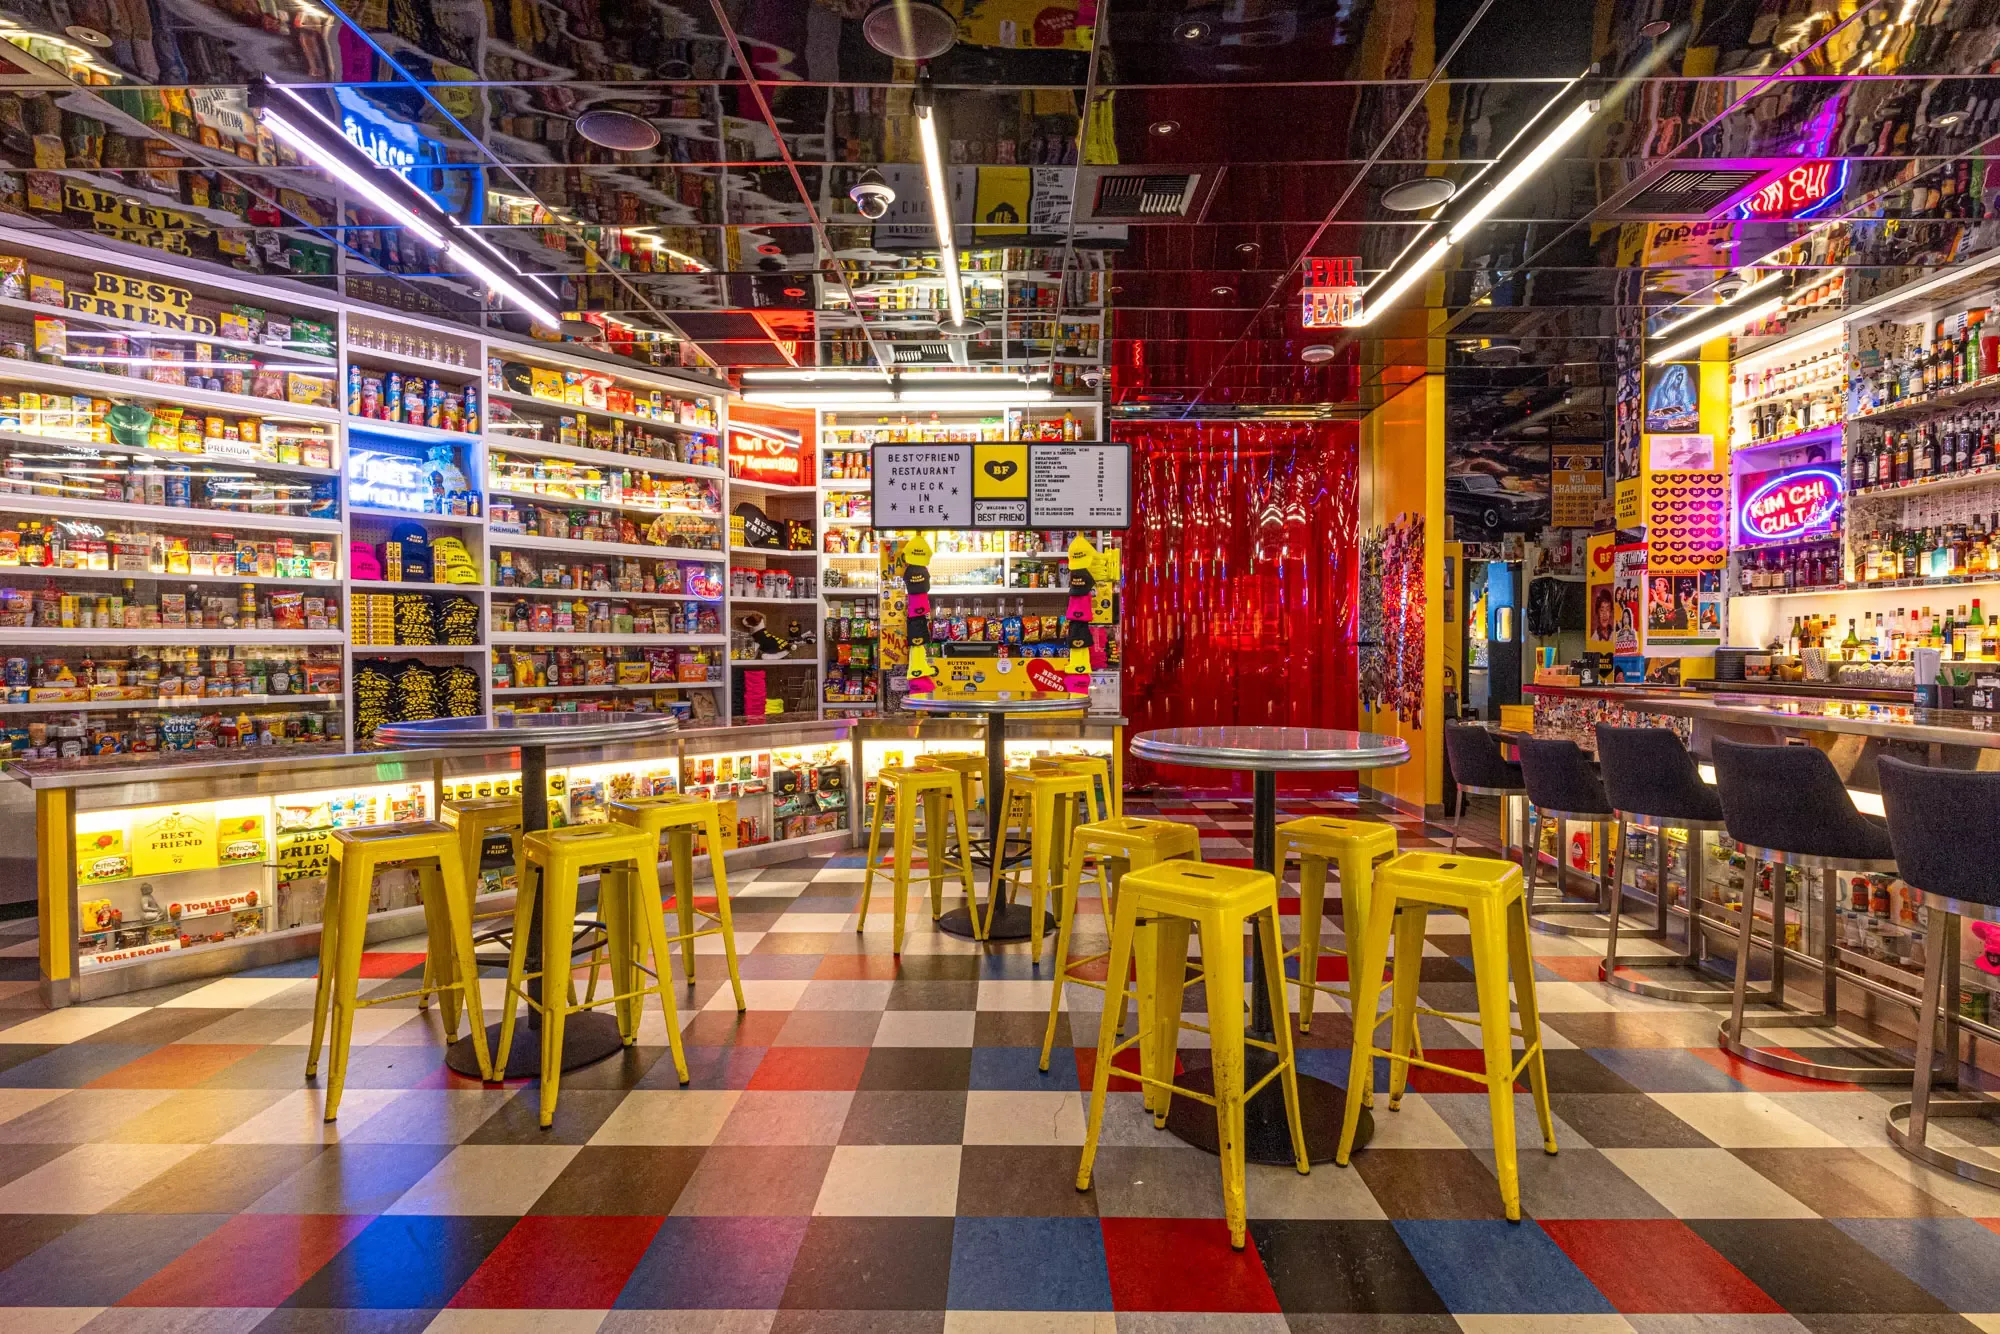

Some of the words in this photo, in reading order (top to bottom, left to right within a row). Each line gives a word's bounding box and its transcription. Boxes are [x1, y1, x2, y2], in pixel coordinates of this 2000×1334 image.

[98, 275, 189, 308] BEST
[1312, 293, 1358, 323] EXIT
[71, 295, 214, 335] FRIEND
[207, 444, 250, 455] PREMIUM
[888, 454, 913, 462] BEST
[925, 453, 960, 462] FRIEND
[892, 467, 955, 475] RESTAURANT
[993, 466, 1010, 474] BF
[1570, 475, 1586, 483] NBA
[902, 482, 944, 490] CHECK
[1553, 485, 1601, 493] CHAMPIONS
[1618, 496, 1637, 504] FRIEND
[1750, 492, 1784, 520] KIM
[1789, 480, 1825, 502] CHI
[910, 505, 943, 513] HERE
[1760, 505, 1810, 533] CULT
[489, 526, 520, 535] PREMIUM
[754, 517, 777, 535] BEST
[1600, 552, 1611, 563] BF
[1042, 669, 1062, 683] BEST
[1034, 673, 1064, 692] FRIEND
[160, 831, 193, 840] BEST
[293, 832, 327, 842] BES
[151, 839, 202, 850] FRIEND
[280, 843, 329, 860] FRIE
[282, 869, 328, 881] VEGA
[184, 895, 246, 913] TOBLERON
[96, 944, 171, 964] TOBLERONE
